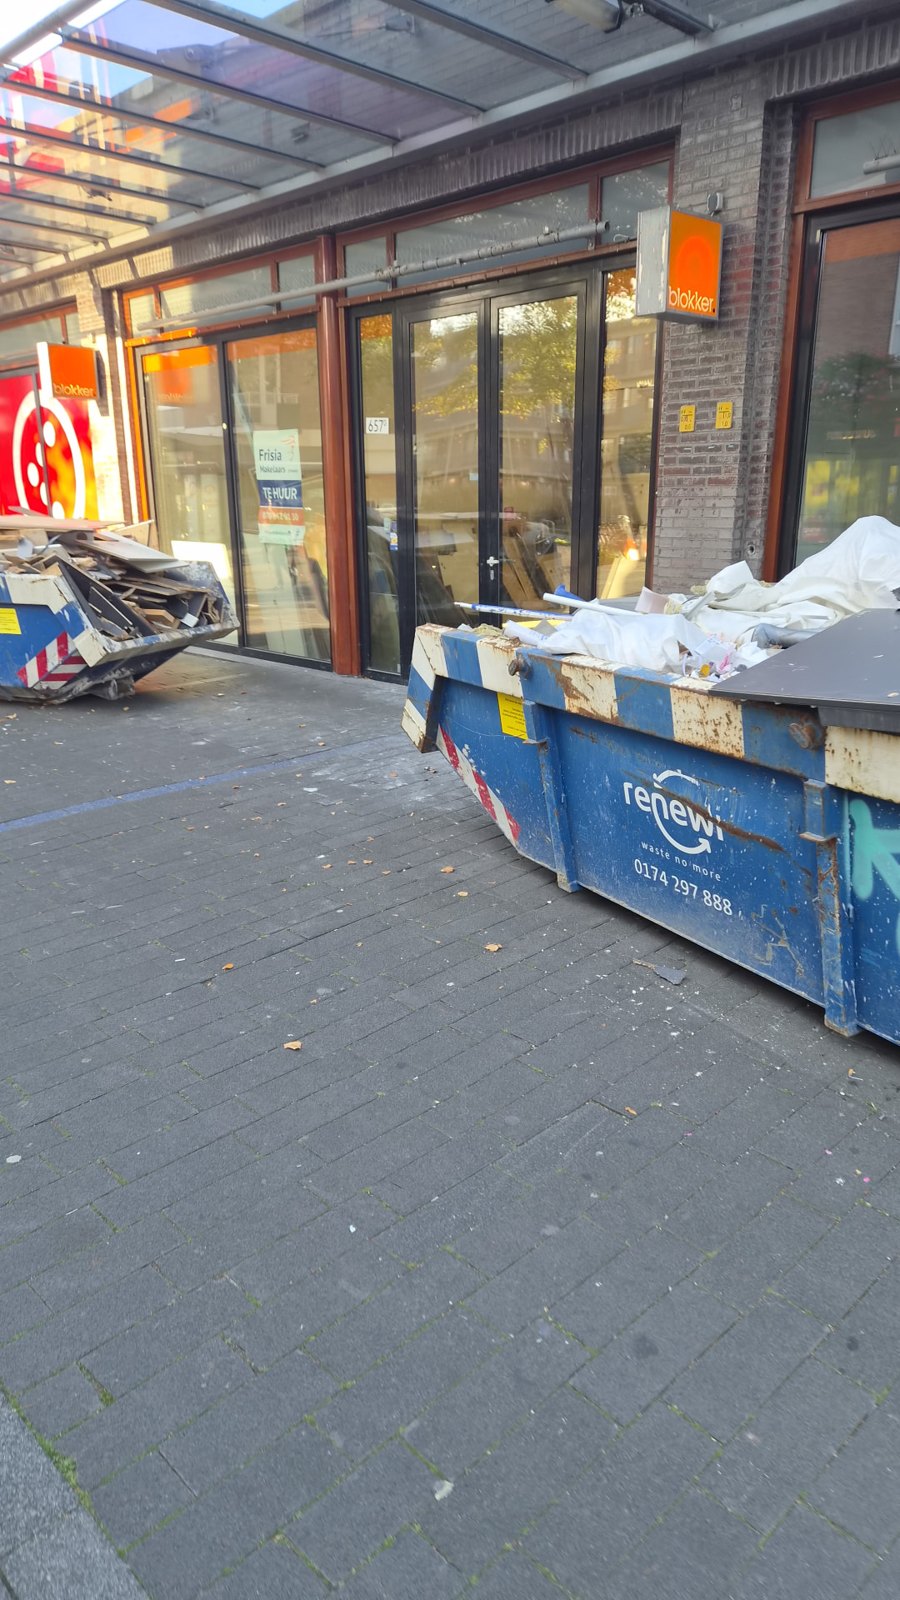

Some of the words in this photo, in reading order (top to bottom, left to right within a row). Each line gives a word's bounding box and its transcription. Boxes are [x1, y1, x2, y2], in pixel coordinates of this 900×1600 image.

[258, 448, 282, 461] Frisia
[262, 487, 272, 500] TE
[272, 487, 298, 500] HUUR
[623, 782, 724, 841] renewi
[641, 840, 670, 860] waste
[675, 855, 688, 867] no
[692, 863, 721, 882] more
[634, 858, 669, 887] 0174
[671, 875, 698, 899] 297
[702, 889, 733, 916] 888
